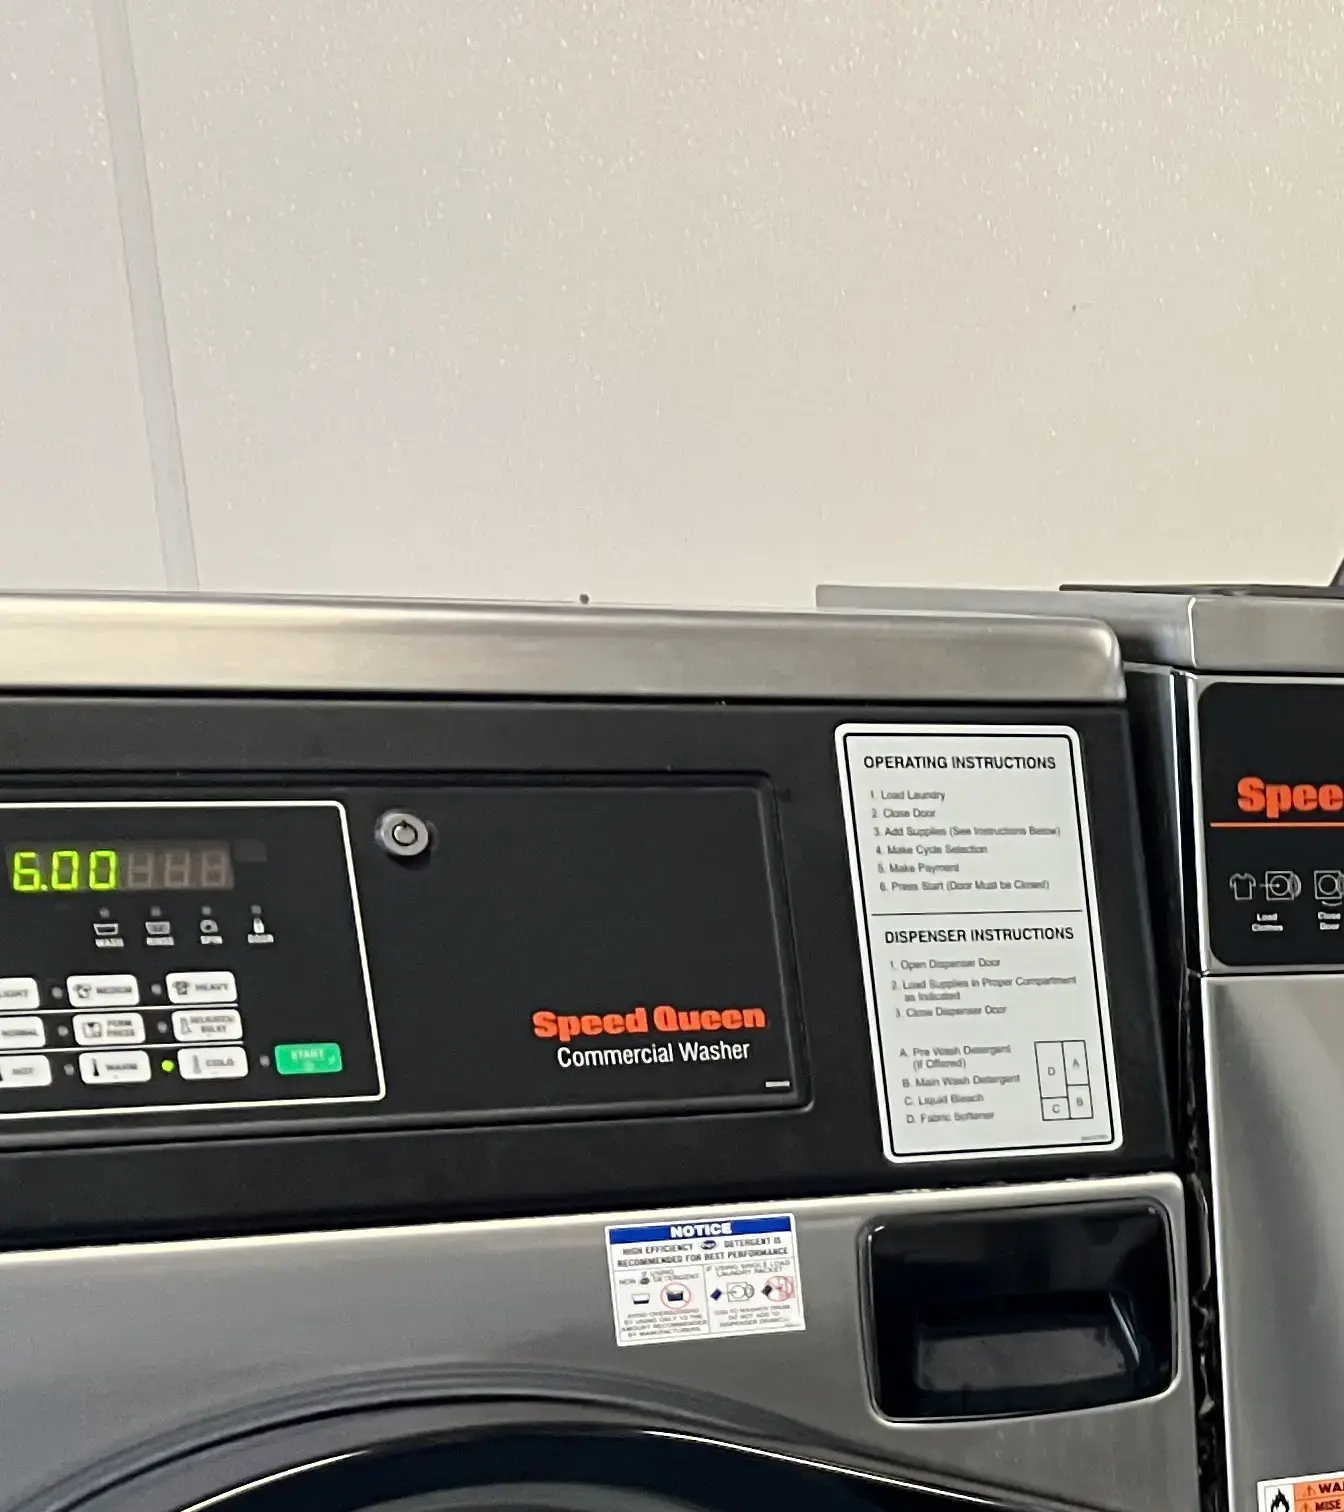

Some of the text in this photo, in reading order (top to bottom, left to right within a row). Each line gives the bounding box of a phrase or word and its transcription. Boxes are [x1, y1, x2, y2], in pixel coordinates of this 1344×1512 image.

[863, 755, 1056, 769] OPERATING INSTRUCTIONS
[907, 790, 945, 801] Laundry
[885, 826, 904, 837] Add
[13, 850, 118, 892] 6.00
[885, 927, 1074, 944] DISPENSER INSTRUCTIONS
[532, 1005, 766, 1042] Speed Queen
[557, 1040, 750, 1068] Commercial Washer
[1072, 1059, 1080, 1068] A
[1047, 1067, 1056, 1076] D
[1051, 1104, 1061, 1113] C
[670, 1223, 732, 1238] NOTICE
[1315, 1500, 1341, 1512] MISE
